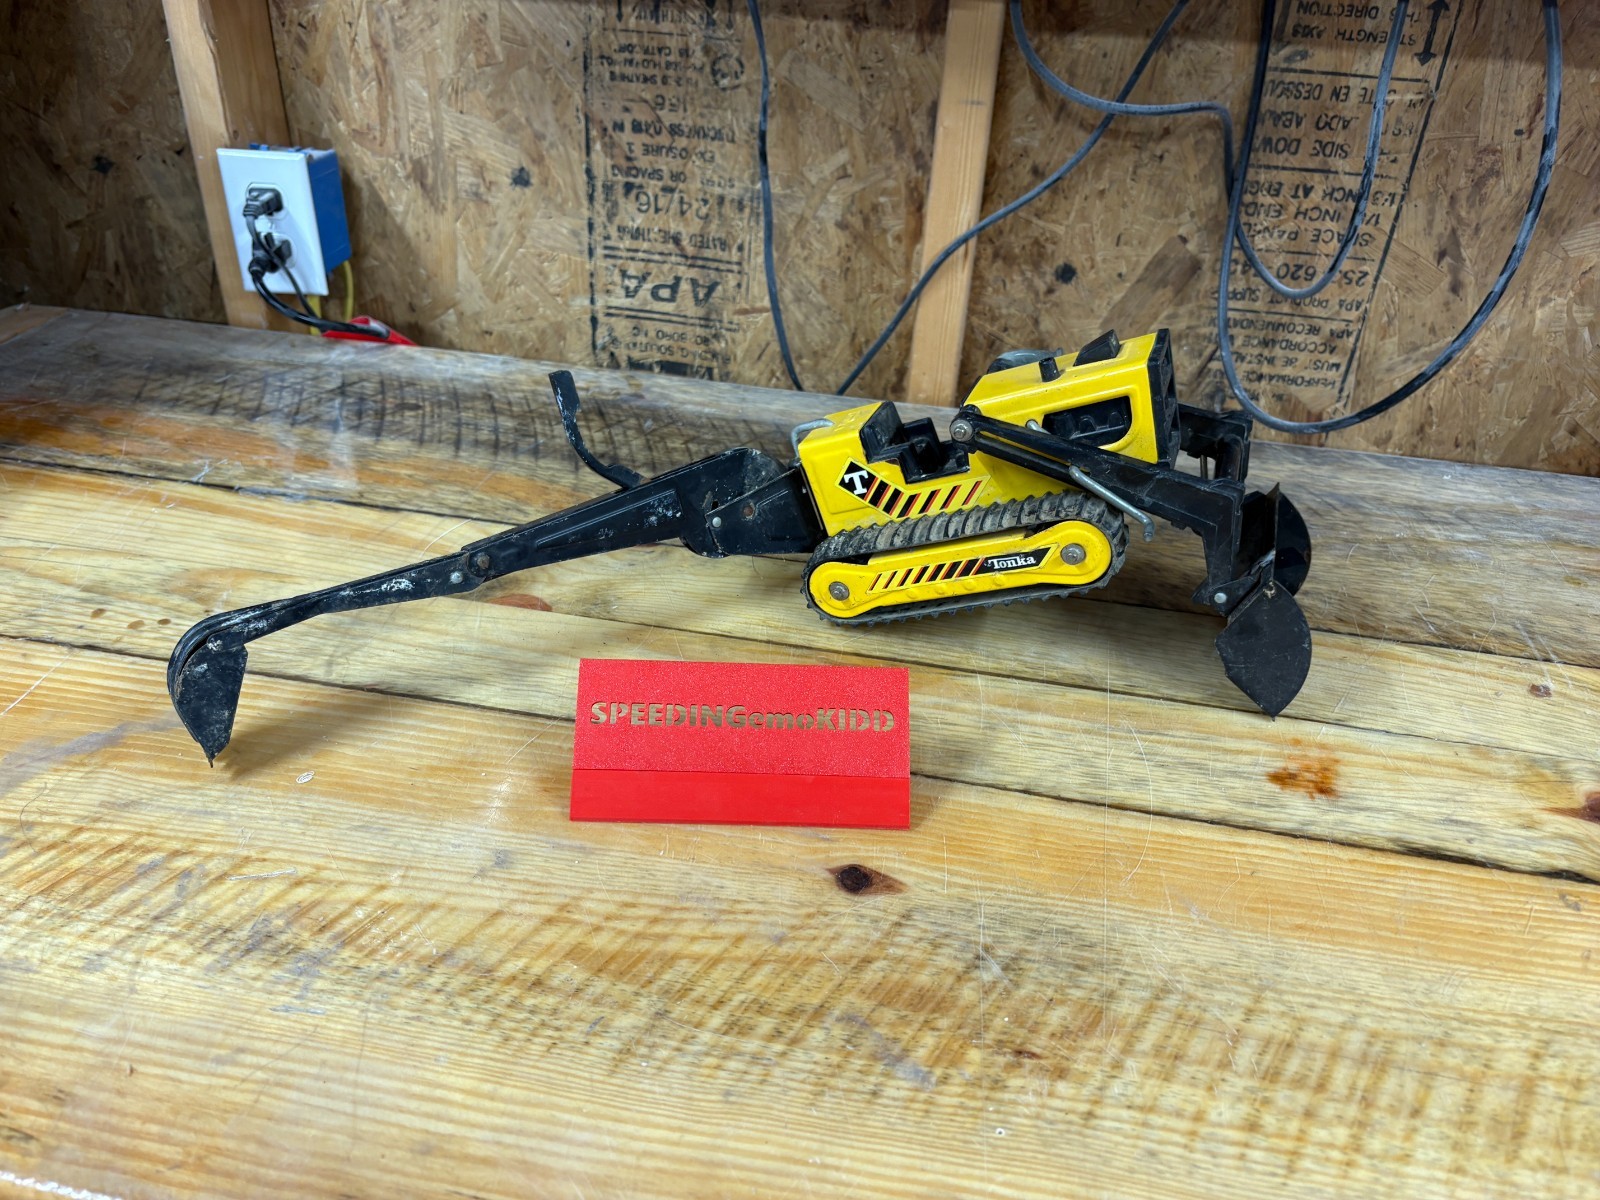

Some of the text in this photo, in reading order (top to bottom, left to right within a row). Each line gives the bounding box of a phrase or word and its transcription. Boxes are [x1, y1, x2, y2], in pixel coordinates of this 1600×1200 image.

[1296, 1, 1421, 23] THS DIRECTION
[1336, 29, 1416, 46] STENGTH
[1263, 78, 1324, 100] DESSOU
[1330, 85, 1350, 101] EN
[641, 142, 716, 163] EXOSURE
[1310, 139, 1351, 160] SIDE
[1290, 184, 1315, 199] AT
[1323, 185, 1360, 202] NCH
[1239, 202, 1284, 219] END
[1294, 206, 1341, 223] INCH
[689, 233, 728, 252] RATED
[1311, 228, 1375, 247] SACE
[619, 268, 721, 308] APA
[1338, 298, 1363, 312] APA
[1328, 327, 1355, 340] APA
[1242, 334, 1337, 355] ACCORDANCE
[843, 469, 869, 495] T
[987, 555, 1037, 570] Tonka
[590, 701, 895, 732] SPEEDINGemoKIDD
